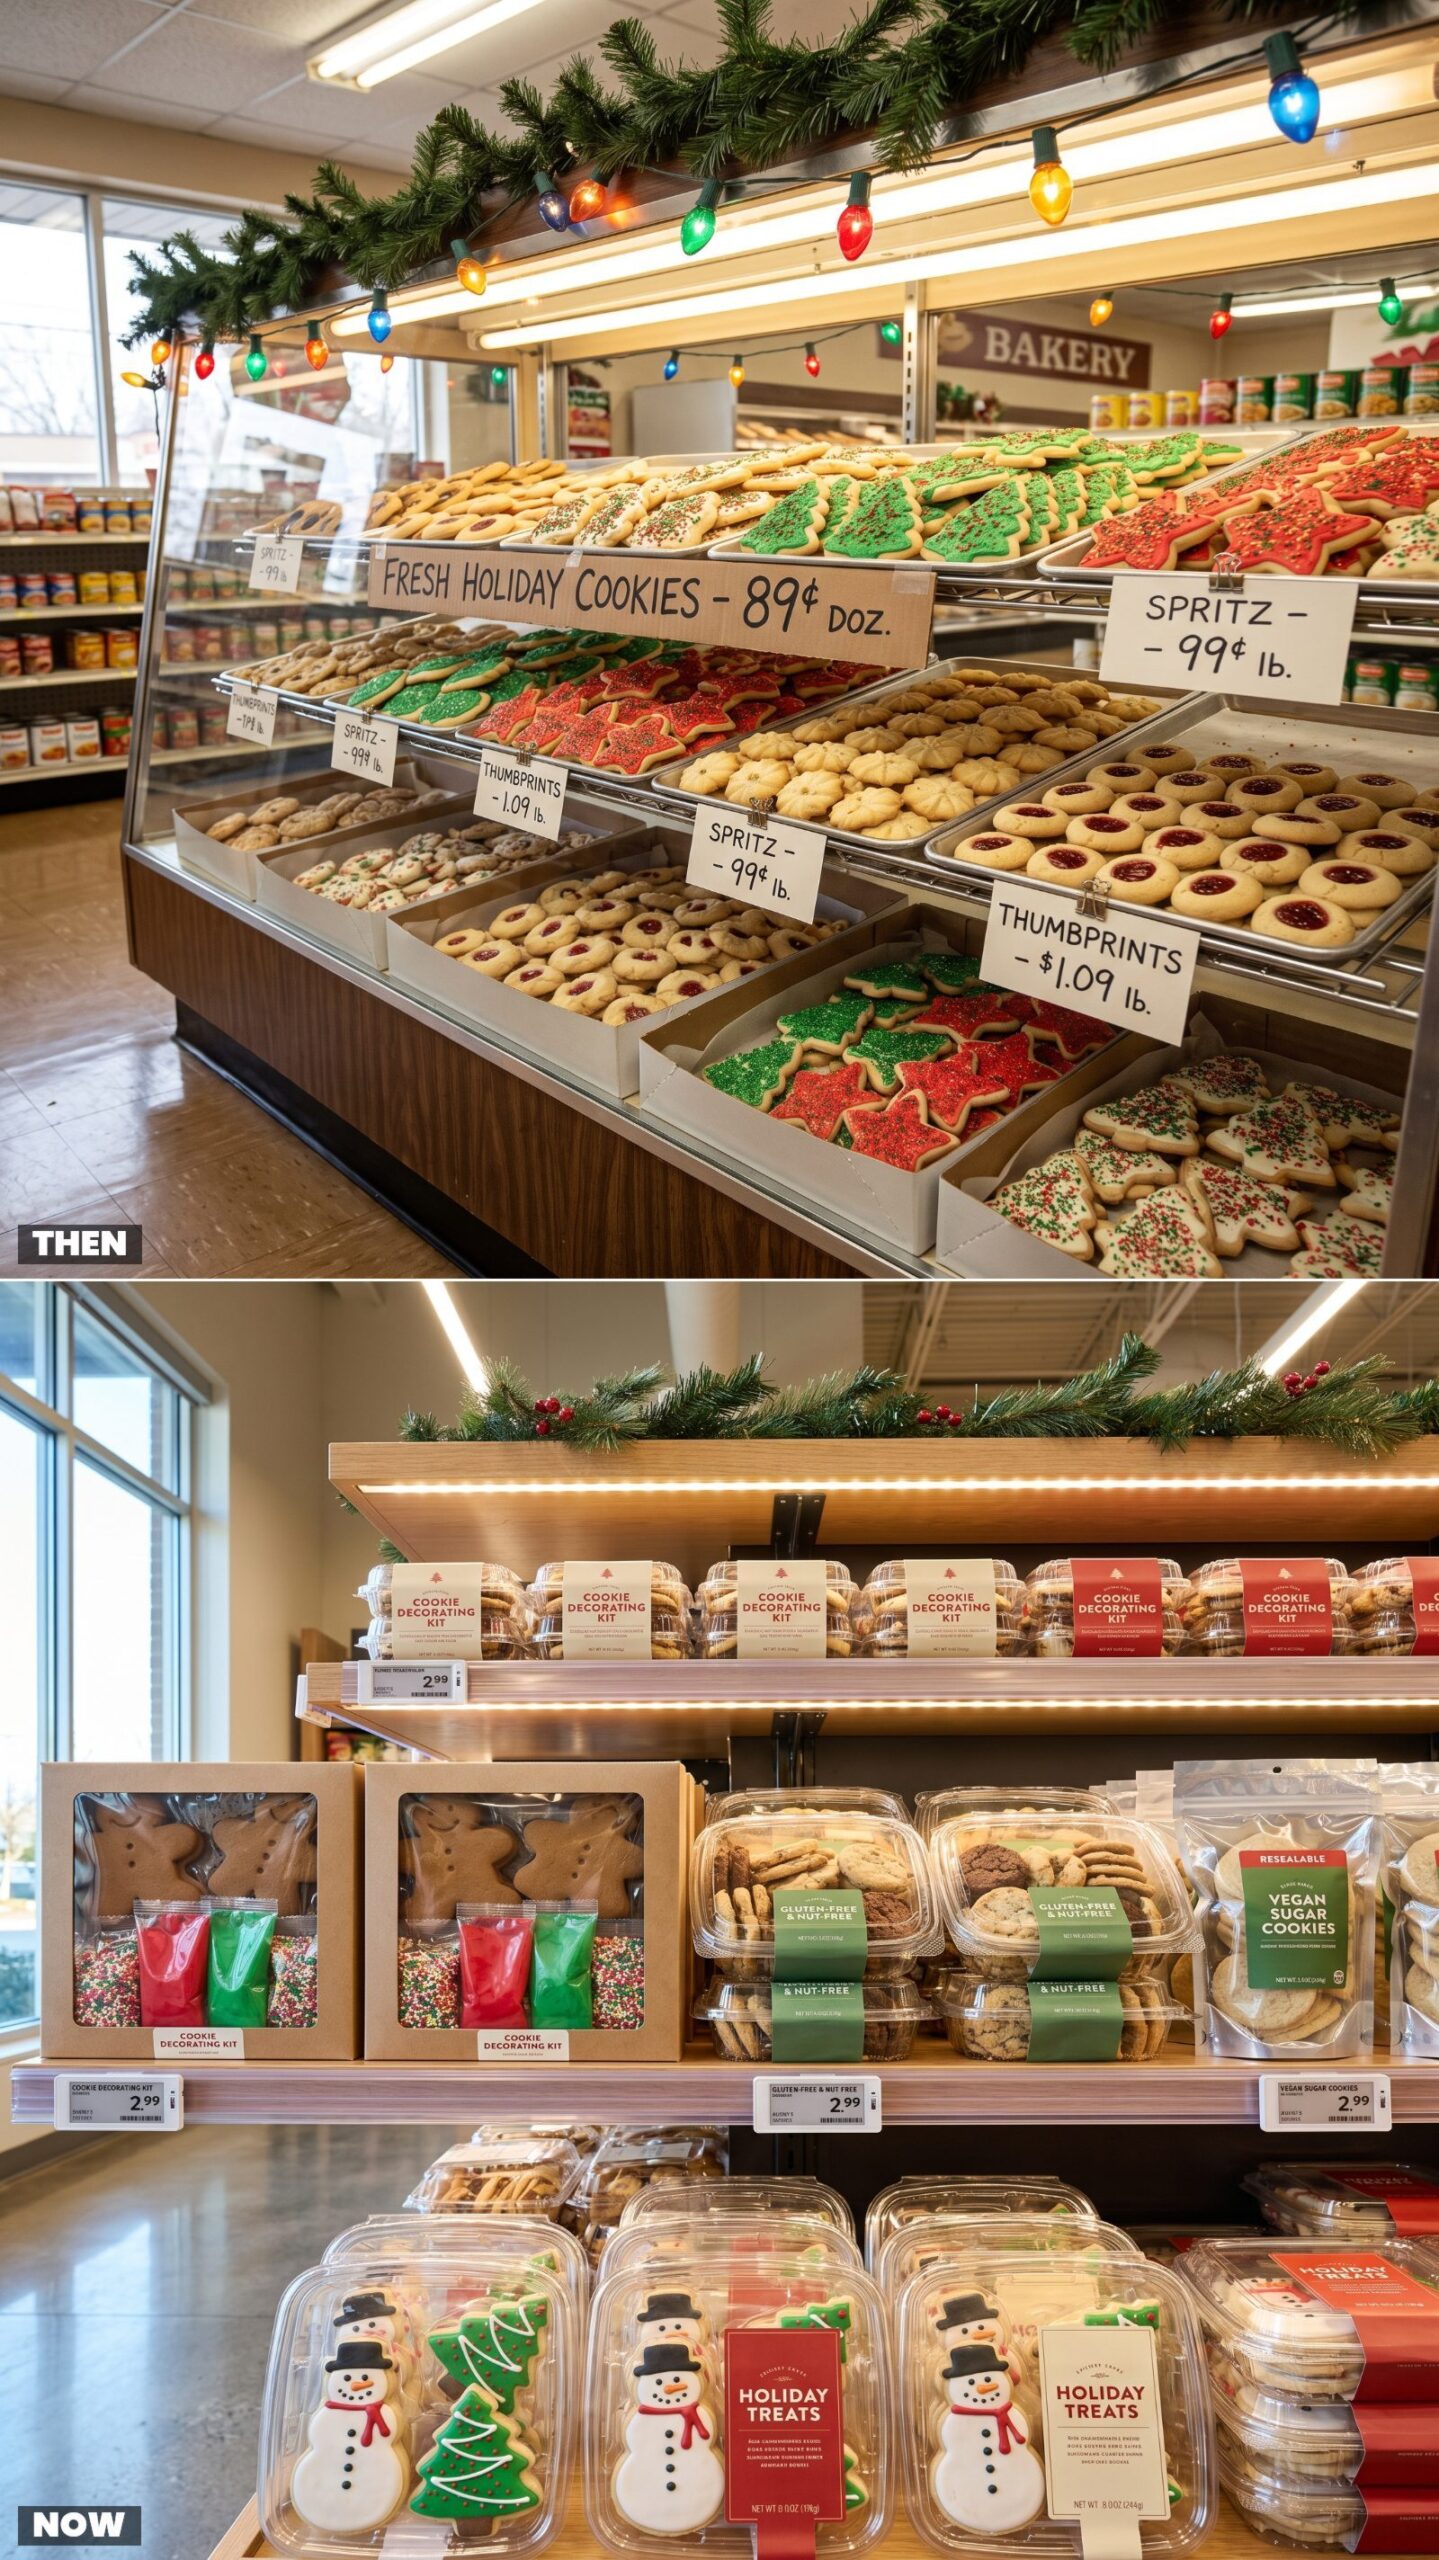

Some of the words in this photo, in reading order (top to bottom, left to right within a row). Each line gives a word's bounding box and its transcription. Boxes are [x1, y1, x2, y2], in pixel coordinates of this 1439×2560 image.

[985, 326, 1135, 380] BAKERY
[261, 547, 287, 561] SPRITZ
[384, 558, 450, 599] FRESH
[463, 562, 564, 610] HOLIDAY
[576, 569, 701, 619] COOKIES
[743, 575, 819, 632] 89¢
[829, 605, 891, 636] DOZ.
[1146, 595, 1273, 625] SPRITZ
[1179, 634, 1246, 674] 99¢
[1259, 651, 1292, 678] lb.
[344, 724, 378, 745] SPRITZ
[483, 761, 561, 798] THUMBPRINTS
[502, 791, 530, 819] 1.09
[533, 807, 546, 824] lb.
[709, 822, 777, 857] SPRITZ
[731, 858, 768, 890] 99¢
[772, 878, 790, 900] lb.
[999, 902, 1182, 974] THUMBPRINTS
[1039, 950, 1114, 1002] $1.09
[1125, 986, 1151, 1015] lb.
[583, 1593, 630, 1601] COOKIE
[758, 1593, 805, 1601] COOKIE
[928, 1593, 974, 1602] COOKIE
[1094, 1594, 1140, 1603] COOKIE
[1263, 1594, 1310, 1602] COOKIE
[413, 1598, 459, 1606] COOKIE
[568, 1603, 646, 1612] DECORATING
[743, 1603, 821, 1612] DECORATING
[912, 1603, 991, 1612] DECORATING
[1079, 1604, 1157, 1613] DECORATING
[1248, 1604, 1326, 1613] DECORATING
[397, 1608, 475, 1617] DECORATING
[427, 1618, 446, 1627] KIT
[598, 1614, 616, 1622] KIT
[772, 1614, 791, 1622] KIT
[942, 1614, 961, 1622] KIT
[1108, 1615, 1127, 1623] KIT
[1278, 1614, 1297, 1623] KIT
[1260, 1855, 1326, 1863] RESEALABLE
[1269, 1894, 1326, 1906] VEGAN
[1047, 1910, 1055, 1918] &
[1058, 1910, 1113, 1918] NUT-FREE
[1271, 1908, 1327, 1920] SUGAR
[1262, 1923, 1336, 1934] COOKIES
[784, 1987, 792, 1995] &
[794, 1987, 850, 1995] NUT-FREE
[1041, 1985, 1048, 1993] &
[504, 2034, 541, 2042] COOKIE
[484, 2042, 544, 2050] DECORATING
[547, 2042, 562, 2050] KIT
[130, 2095, 160, 2111] 2.99
[830, 2097, 861, 2113] 2.99
[1338, 2095, 1370, 2111] 2.99
[739, 2389, 829, 2403] HOLIDAY
[1056, 2386, 1145, 2400] HOLIDAY
[747, 2407, 821, 2422] TREATS
[1064, 2404, 1139, 2419] TREATS
[752, 2505, 765, 2513] NET
[765, 2505, 776, 2513] WT
[1073, 2501, 1086, 2509] NET
[1087, 2501, 1099, 2509] WT
